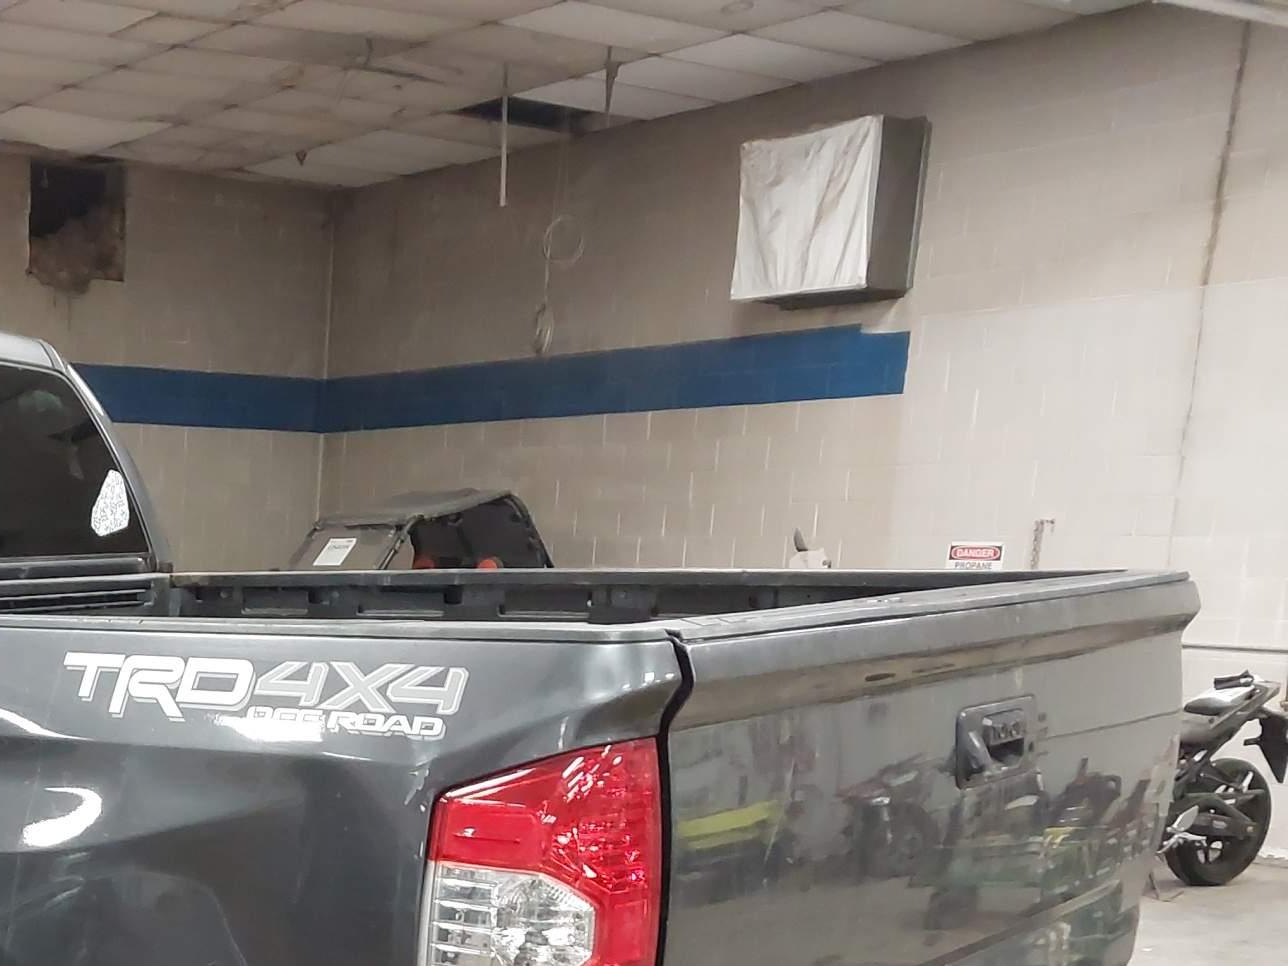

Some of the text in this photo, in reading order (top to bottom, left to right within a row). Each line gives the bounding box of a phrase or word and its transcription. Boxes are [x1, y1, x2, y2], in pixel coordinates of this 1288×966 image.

[956, 548, 995, 558] DANGER
[954, 561, 993, 569] PROPANE
[326, 711, 446, 740] ROAD
